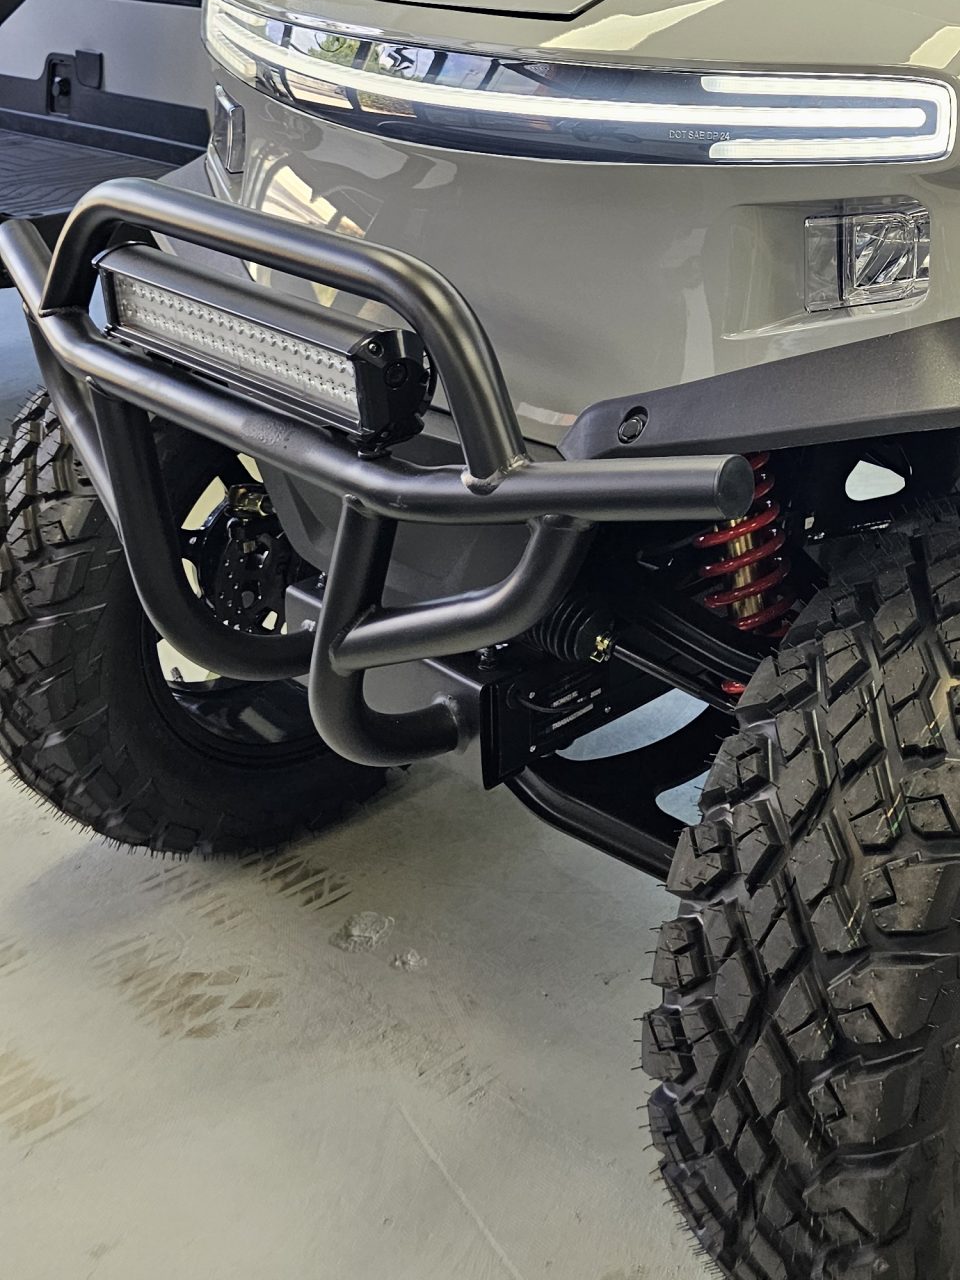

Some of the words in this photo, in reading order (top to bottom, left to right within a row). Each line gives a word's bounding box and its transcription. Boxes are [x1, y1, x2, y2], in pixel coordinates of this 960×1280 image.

[669, 129, 687, 139] DOT
[688, 130, 705, 140] SAE
[720, 131, 731, 140] 24
